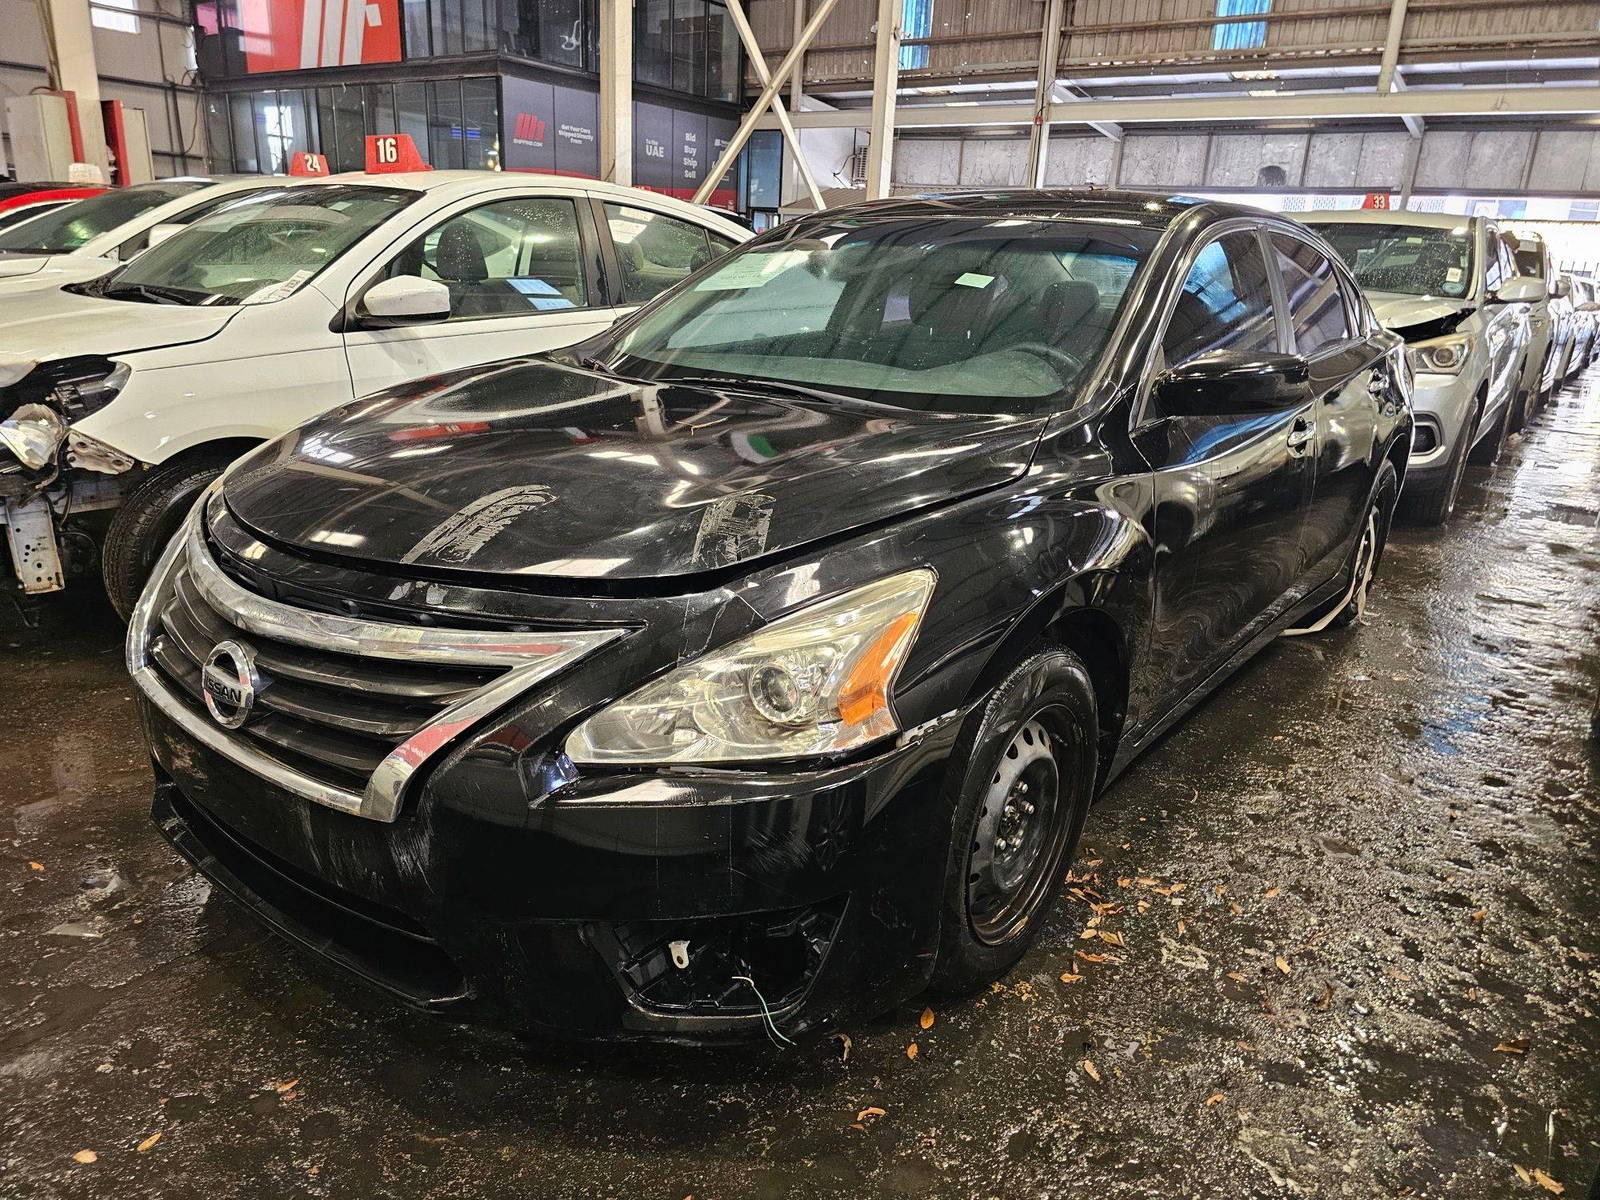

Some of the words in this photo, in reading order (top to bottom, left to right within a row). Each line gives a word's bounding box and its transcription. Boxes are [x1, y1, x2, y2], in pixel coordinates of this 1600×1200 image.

[685, 132, 696, 142] Bid
[376, 138, 397, 163] 16
[645, 145, 664, 158] UAE
[684, 145, 697, 157] Buy
[304, 154, 321, 172] 24
[683, 157, 698, 169] Ship
[684, 169, 696, 179] Sell
[1373, 195, 1385, 209] 33
[205, 674, 242, 704] SSAN
